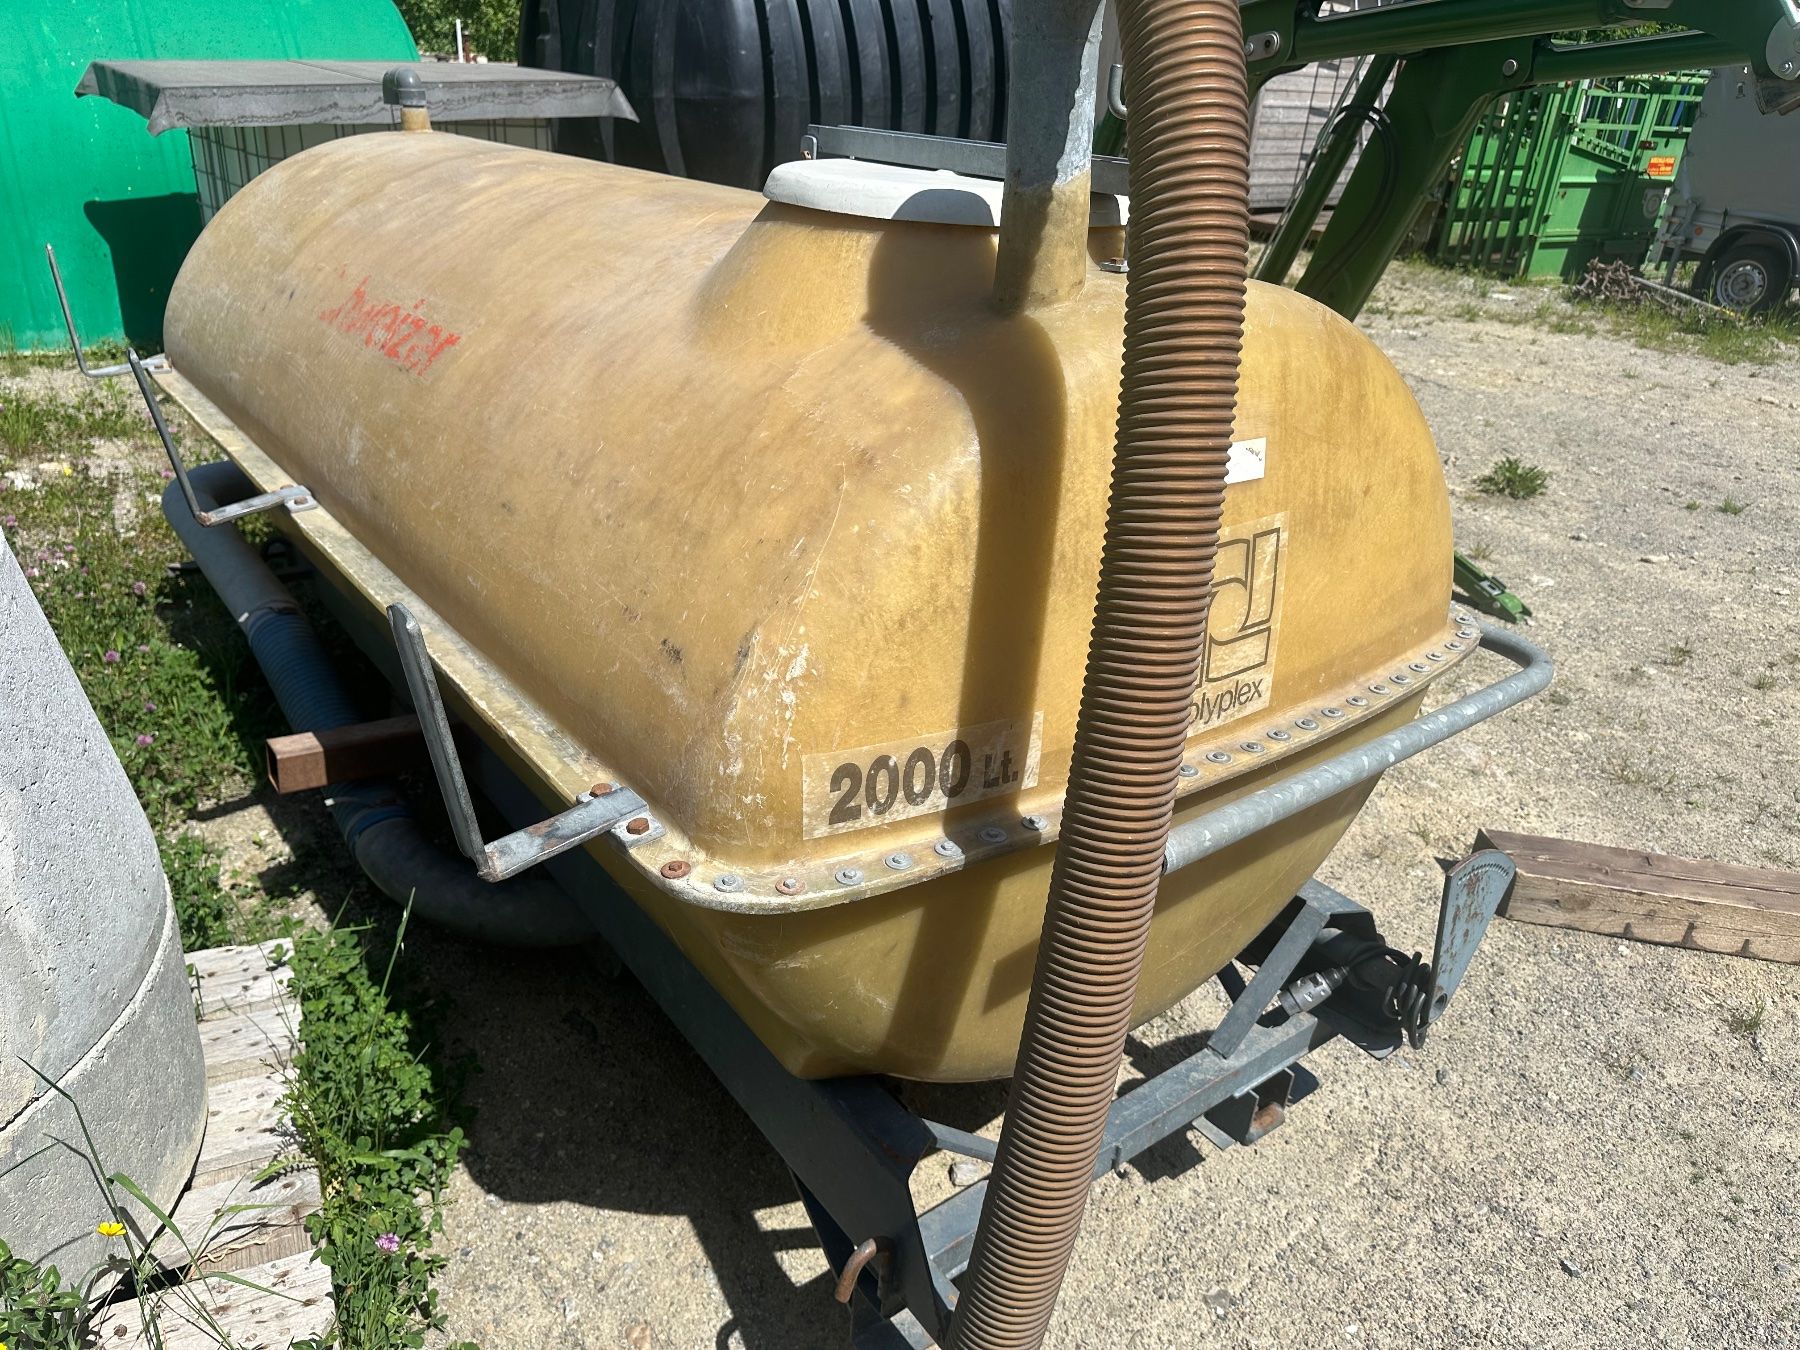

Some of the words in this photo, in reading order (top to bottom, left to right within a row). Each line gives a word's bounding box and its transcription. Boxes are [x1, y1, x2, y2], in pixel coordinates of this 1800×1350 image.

[319, 264, 461, 377] hweizer
[1189, 678, 1263, 725] olyplex
[828, 739, 972, 825] 2000
